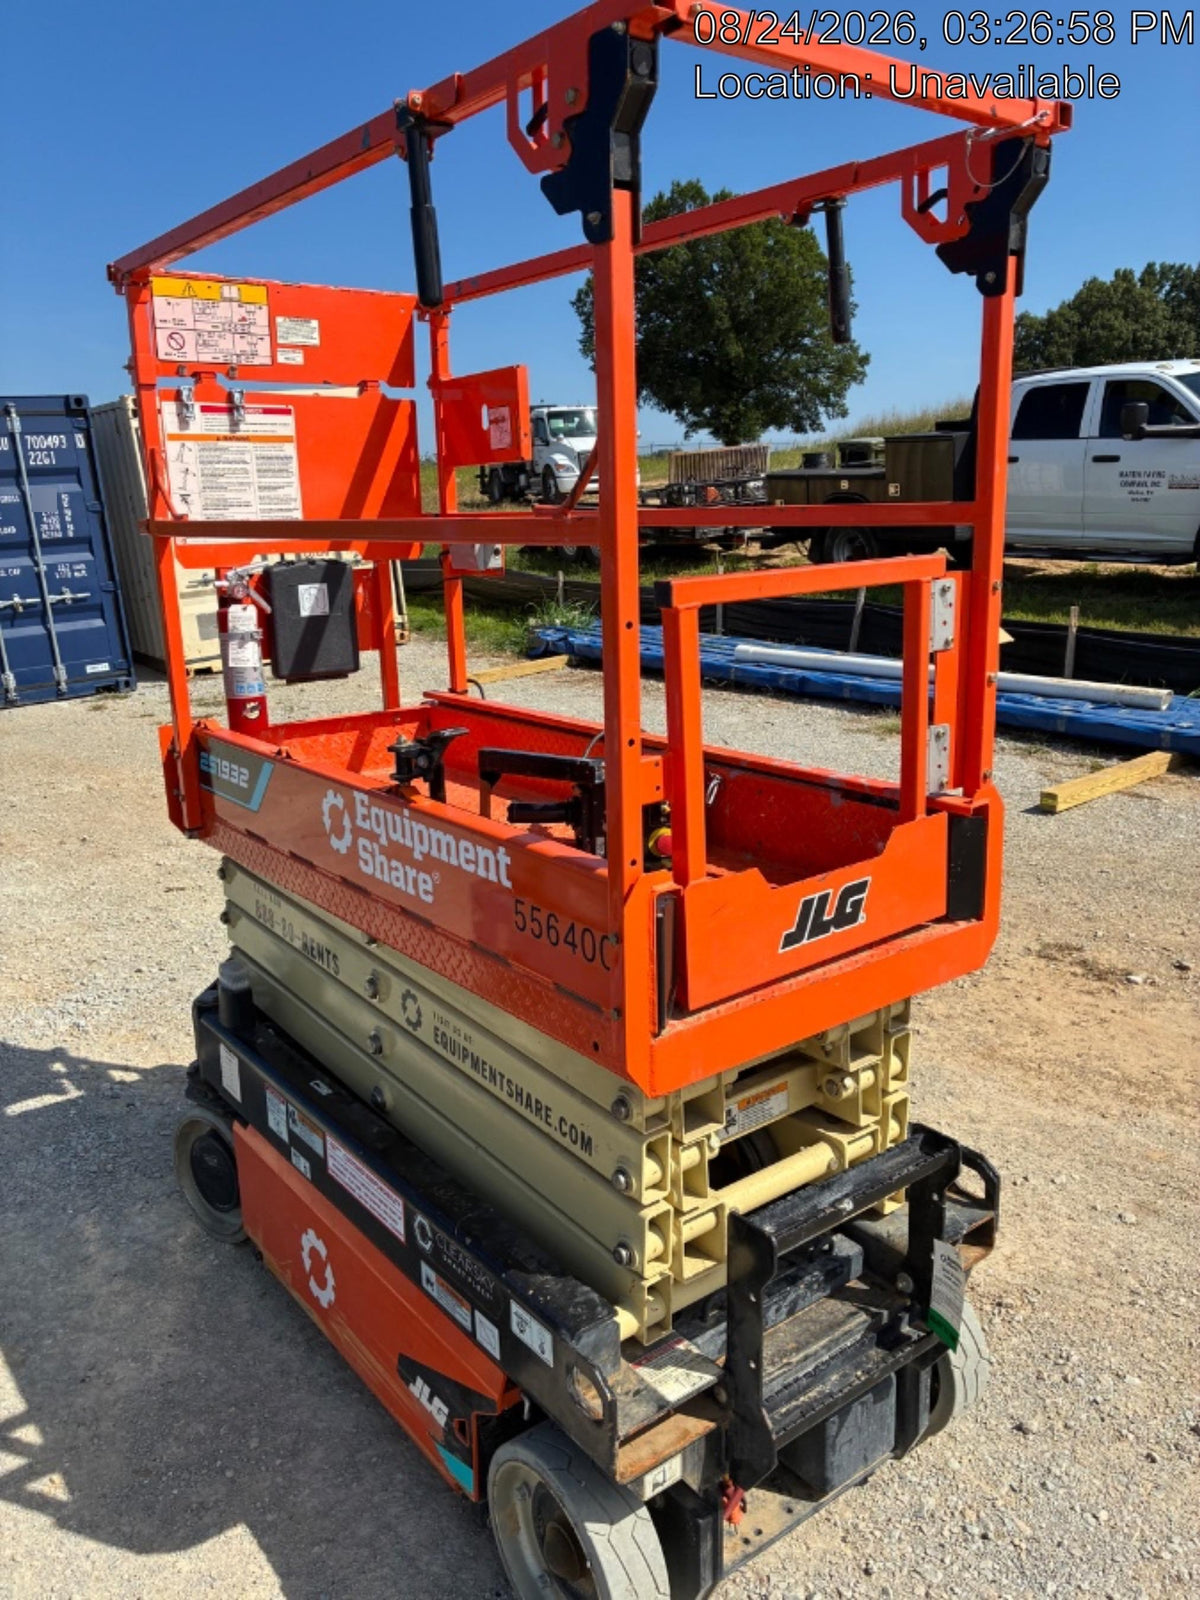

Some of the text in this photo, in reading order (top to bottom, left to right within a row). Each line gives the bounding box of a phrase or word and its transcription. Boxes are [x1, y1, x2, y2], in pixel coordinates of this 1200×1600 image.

[24, 435, 67, 450] 700493
[353, 790, 512, 889] Equipment
[778, 876, 872, 953] JLG
[433, 1026, 593, 1157] EQUIPMENTSHARE.COM
[408, 1375, 449, 1428] JLG
